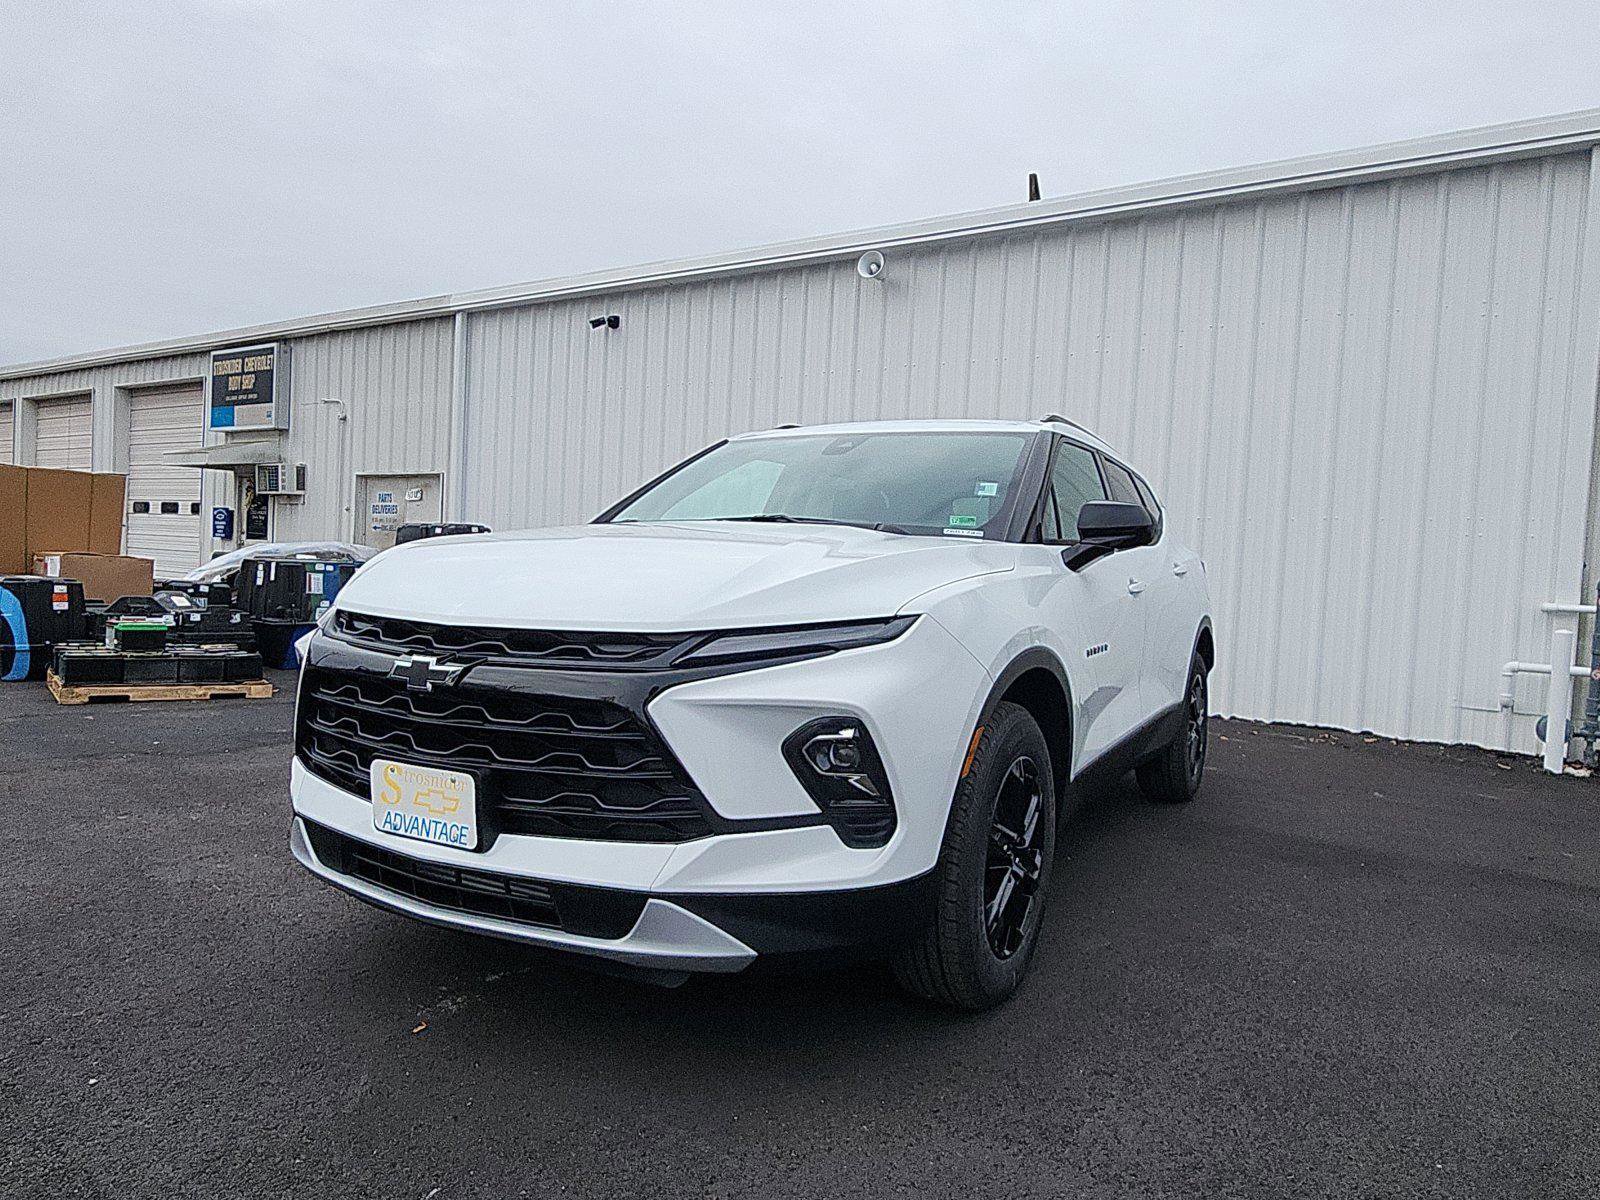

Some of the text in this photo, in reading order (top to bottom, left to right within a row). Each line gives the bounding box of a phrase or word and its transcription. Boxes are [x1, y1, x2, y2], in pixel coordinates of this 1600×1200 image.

[244, 354, 273, 373] CHEVROLET
[228, 373, 256, 391] BODY SHOP
[378, 492, 393, 503] PARTS
[371, 504, 398, 515] DELIVERIES
[382, 811, 469, 846] ADVANTAGE
